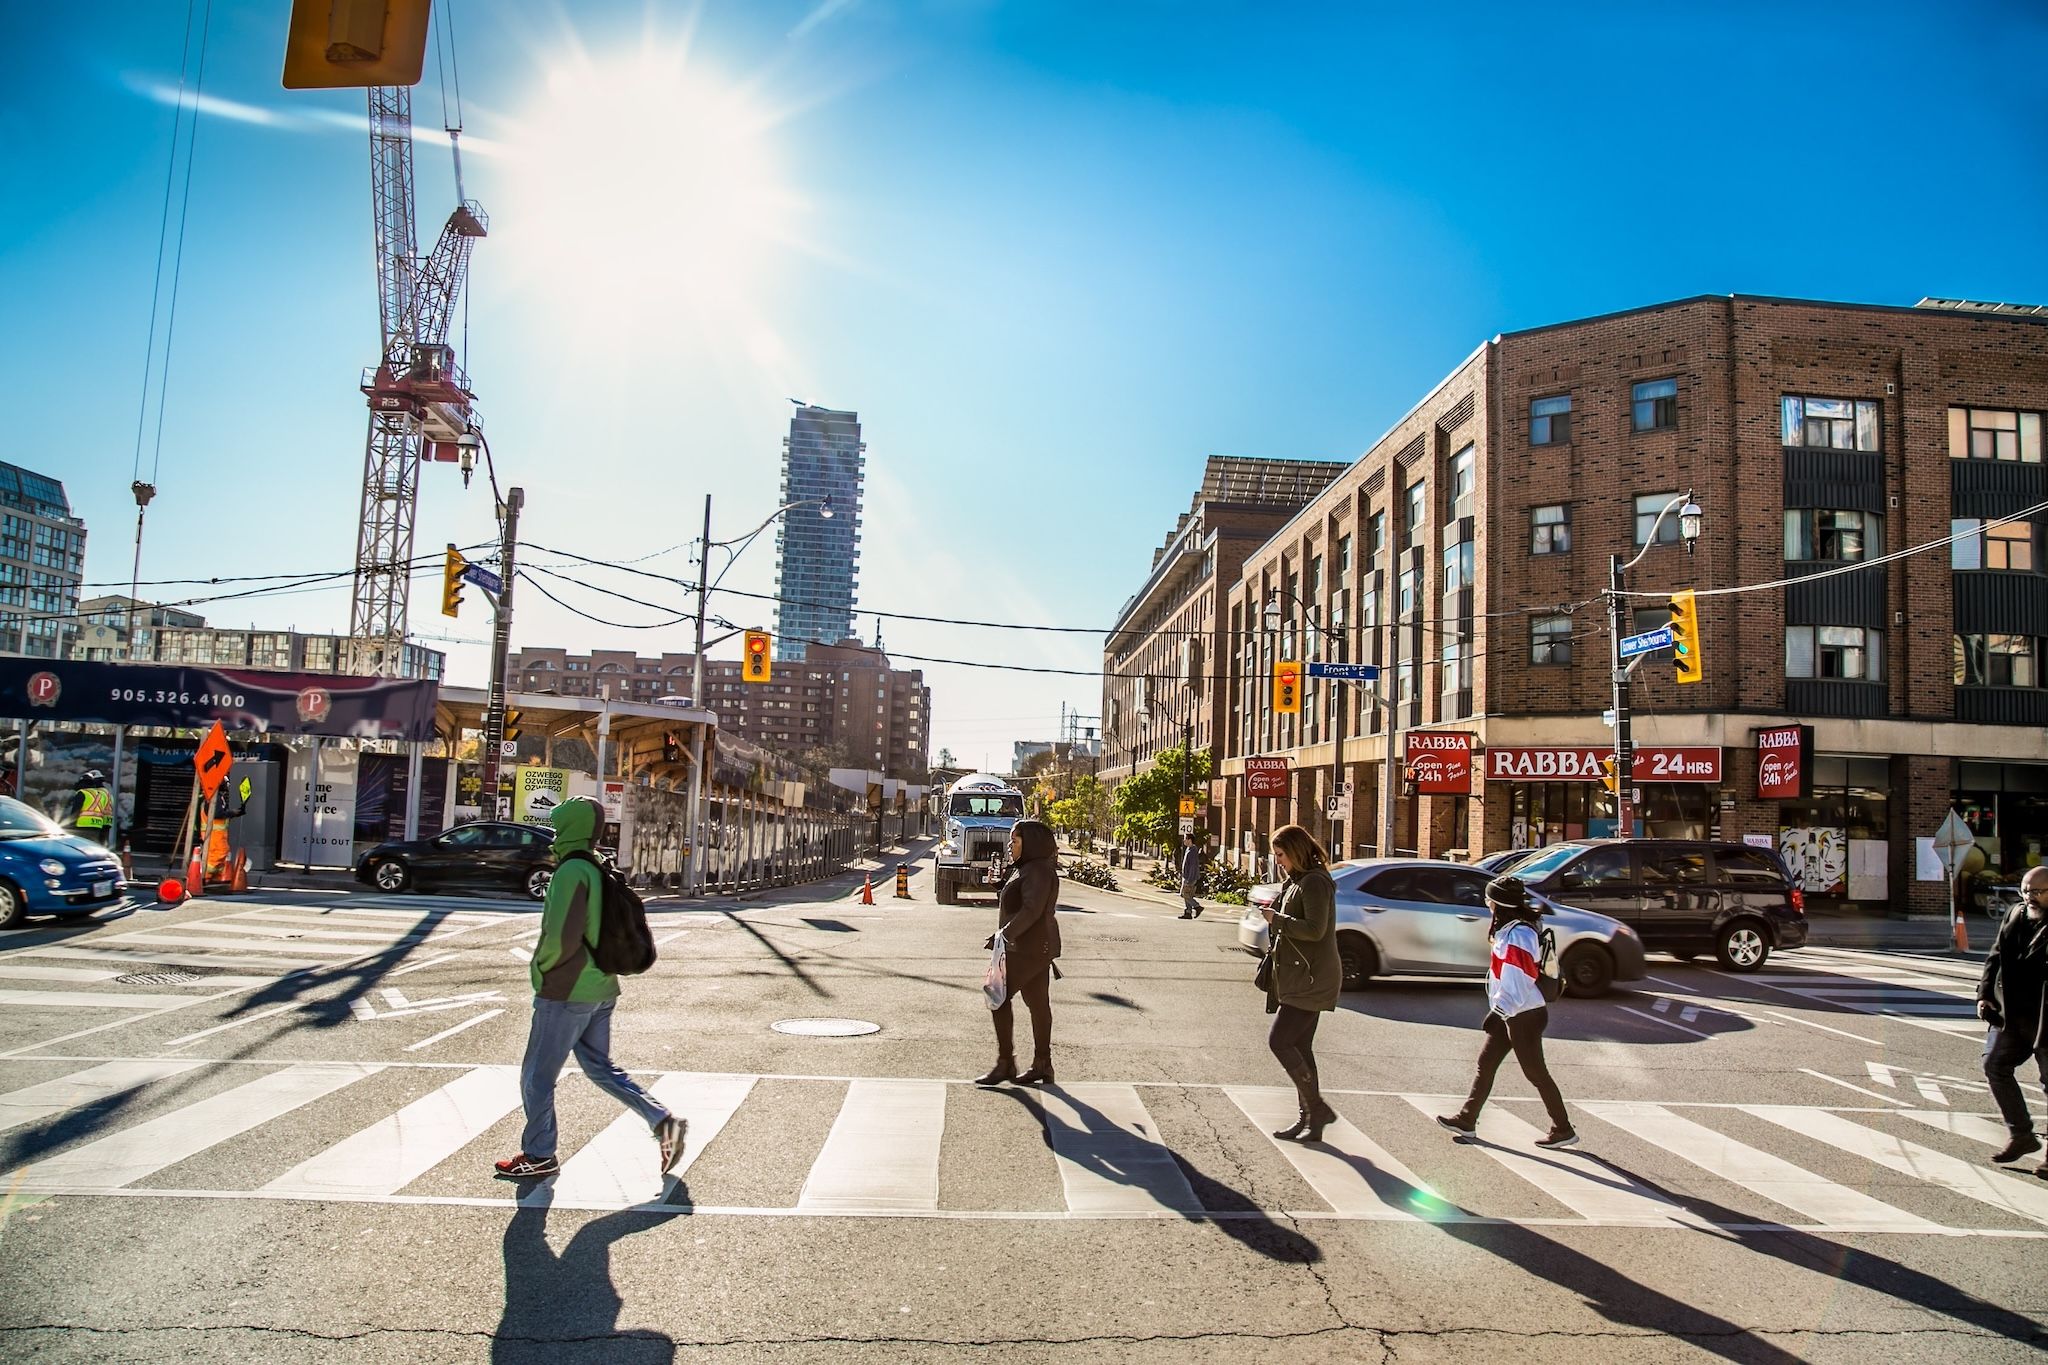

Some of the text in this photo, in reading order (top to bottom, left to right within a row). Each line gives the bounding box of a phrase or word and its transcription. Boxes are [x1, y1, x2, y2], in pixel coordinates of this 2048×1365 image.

[1323, 664, 1349, 676] Front
[1358, 666, 1365, 677] E
[111, 688, 245, 708] 905.326.4100
[1408, 735, 1469, 750] RABBA
[1759, 730, 1800, 749] RABBA
[1247, 760, 1287, 770] RABBA
[1417, 762, 1443, 771] open
[1494, 752, 1603, 776] RABBA
[1652, 753, 1685, 775] 24
[1686, 761, 1714, 775] HRS
[1764, 762, 1782, 774] open
[525, 770, 563, 779] OZWEEGO
[1252, 776, 1270, 784] open
[1417, 769, 1442, 782] 24h
[1763, 771, 1781, 786] 24h
[305, 781, 333, 792] tme
[525, 777, 562, 786] OZWEEGO
[1252, 782, 1270, 790] 24h
[1180, 825, 1192, 833] 40
[331, 838, 350, 846] OUT
